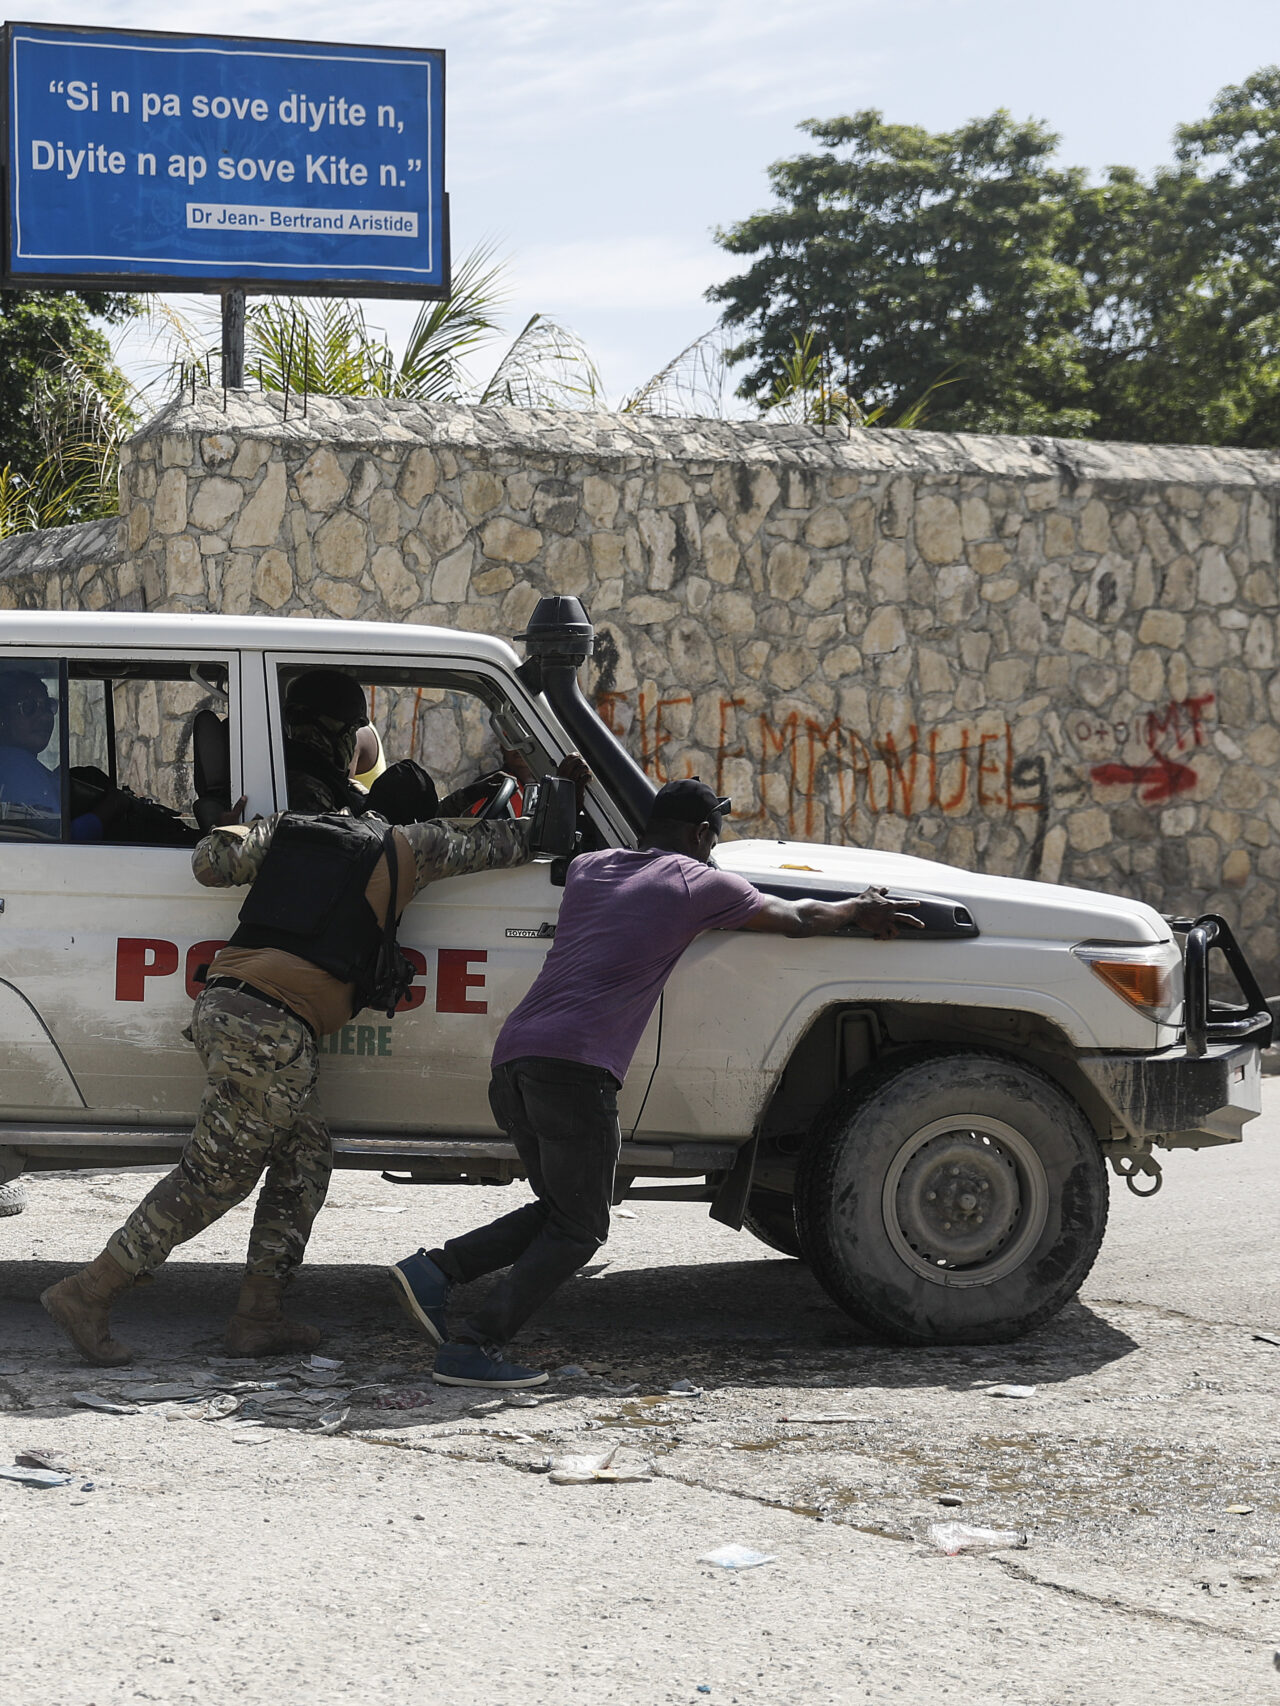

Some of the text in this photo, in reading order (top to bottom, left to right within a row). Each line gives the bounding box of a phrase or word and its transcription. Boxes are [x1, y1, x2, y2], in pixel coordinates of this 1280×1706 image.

[111, 91, 130, 114] n
[142, 93, 181, 123] pa
[191, 95, 269, 122] sove
[278, 93, 366, 132] diyite
[377, 105, 404, 134] n,
[31, 140, 126, 180] Diyite
[137, 153, 156, 176] n
[167, 154, 207, 186] ap
[217, 157, 295, 185] sove
[306, 154, 368, 187] Kite
[191, 207, 414, 232] Dr Jean- Bertrand Aristide
[507, 929, 536, 938] TOYOTA
